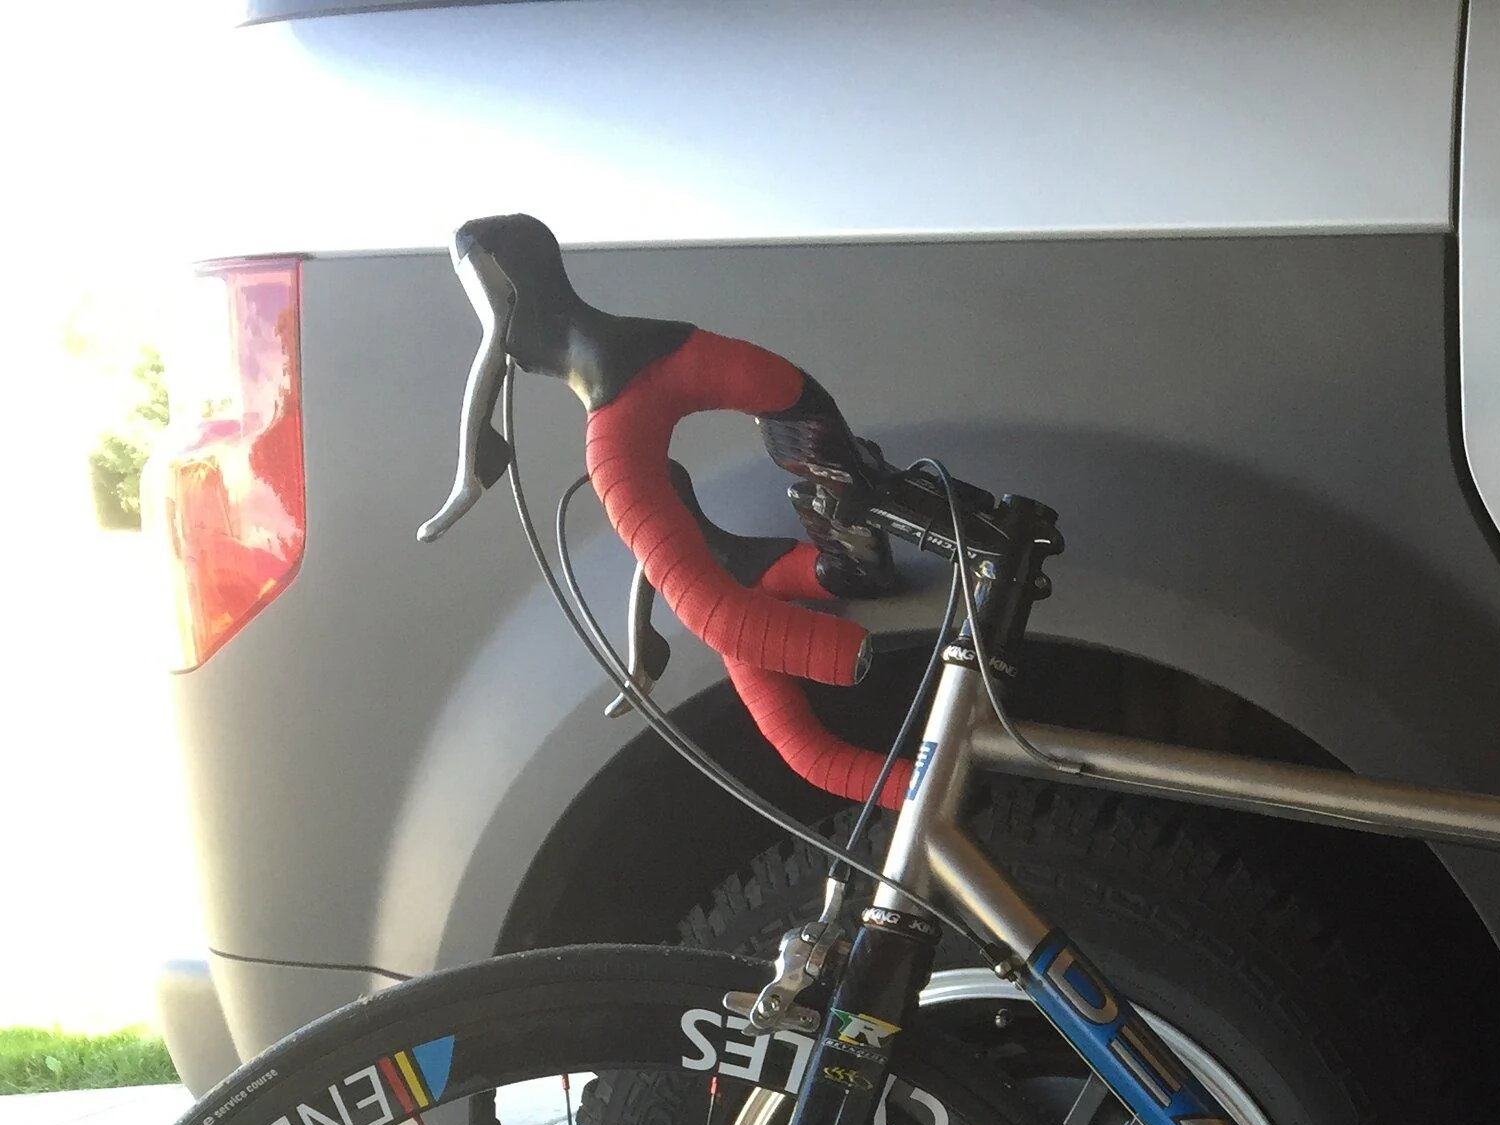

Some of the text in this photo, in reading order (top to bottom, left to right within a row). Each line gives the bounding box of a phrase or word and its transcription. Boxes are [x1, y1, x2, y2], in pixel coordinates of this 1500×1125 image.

[942, 644, 977, 662] KING
[213, 1089, 248, 1119] service
[246, 1067, 279, 1093] course
